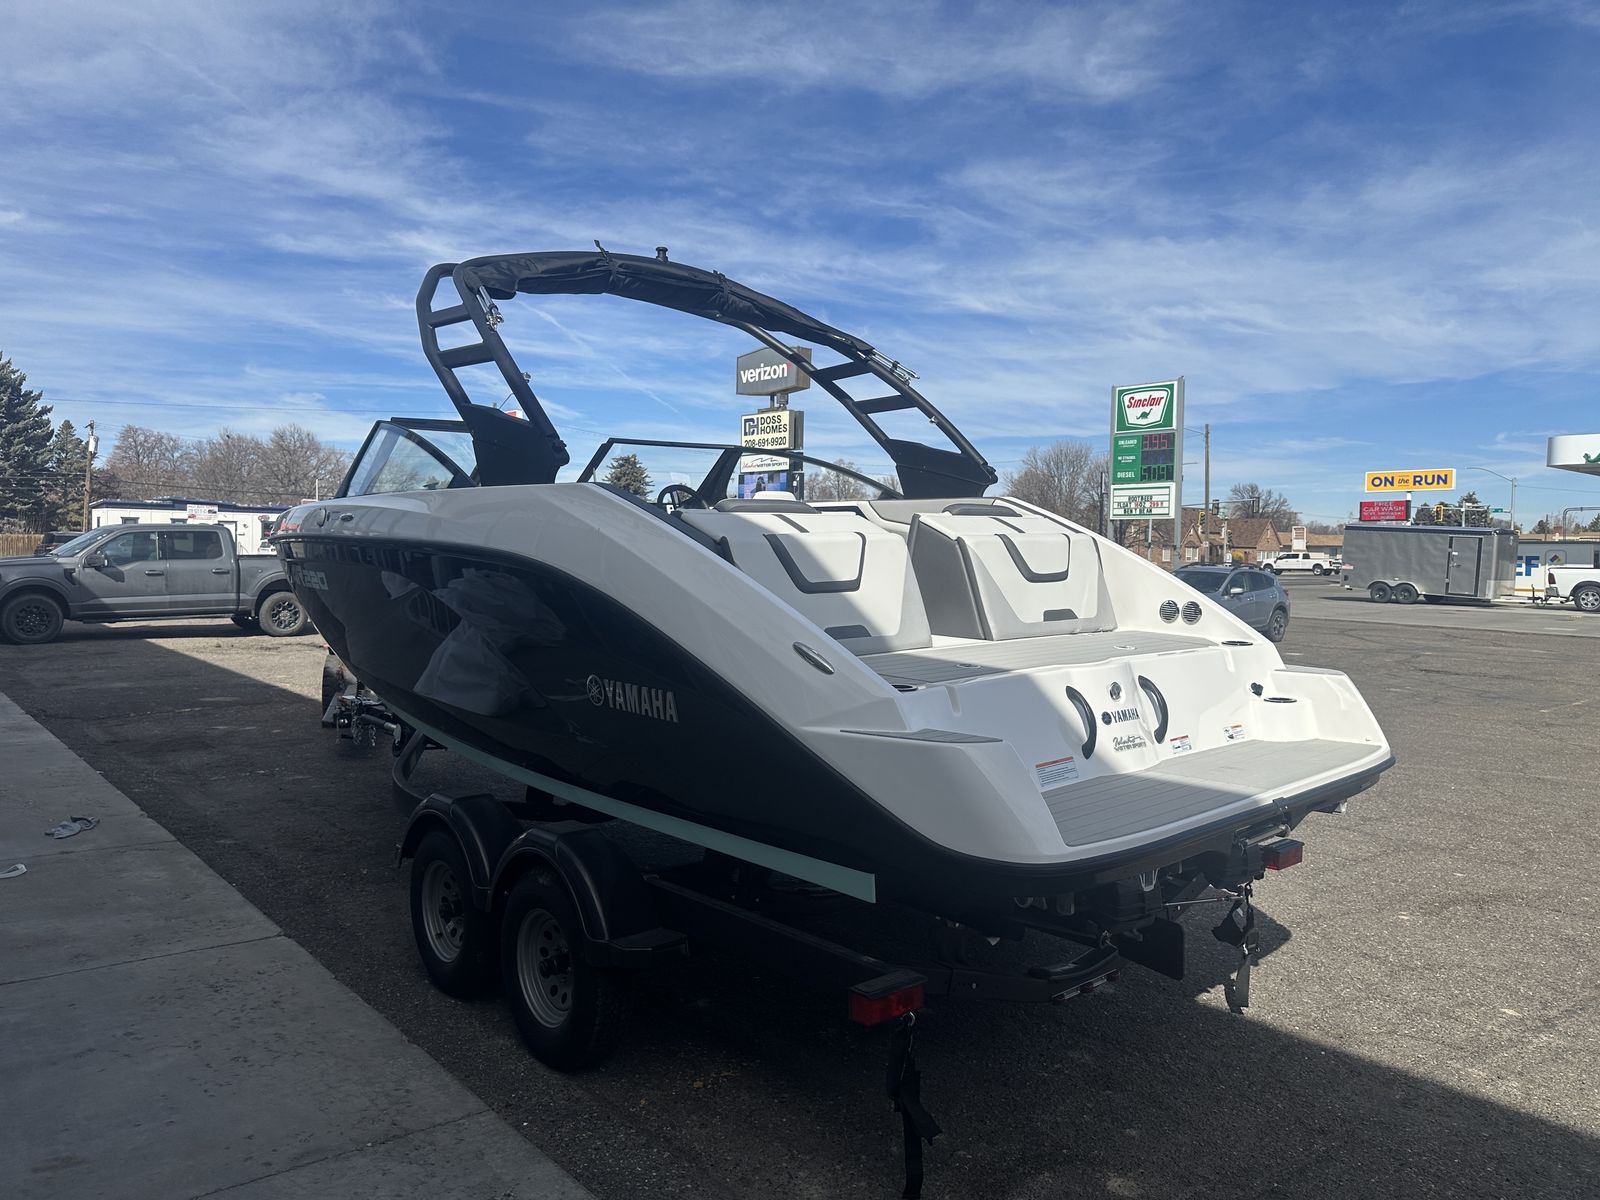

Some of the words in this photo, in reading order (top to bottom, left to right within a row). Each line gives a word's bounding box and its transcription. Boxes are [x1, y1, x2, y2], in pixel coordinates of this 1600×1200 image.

[740, 363, 788, 383] verizon
[1127, 395, 1165, 408] Sinclair
[760, 415, 782, 425] DOSS
[760, 424, 788, 435] HOMES
[744, 436, 787, 448] 208-691-9920
[1371, 476, 1395, 487] ON
[1412, 474, 1448, 486] RUN
[603, 679, 679, 723] YAMAHA
[1111, 708, 1140, 723] YAMAHA
